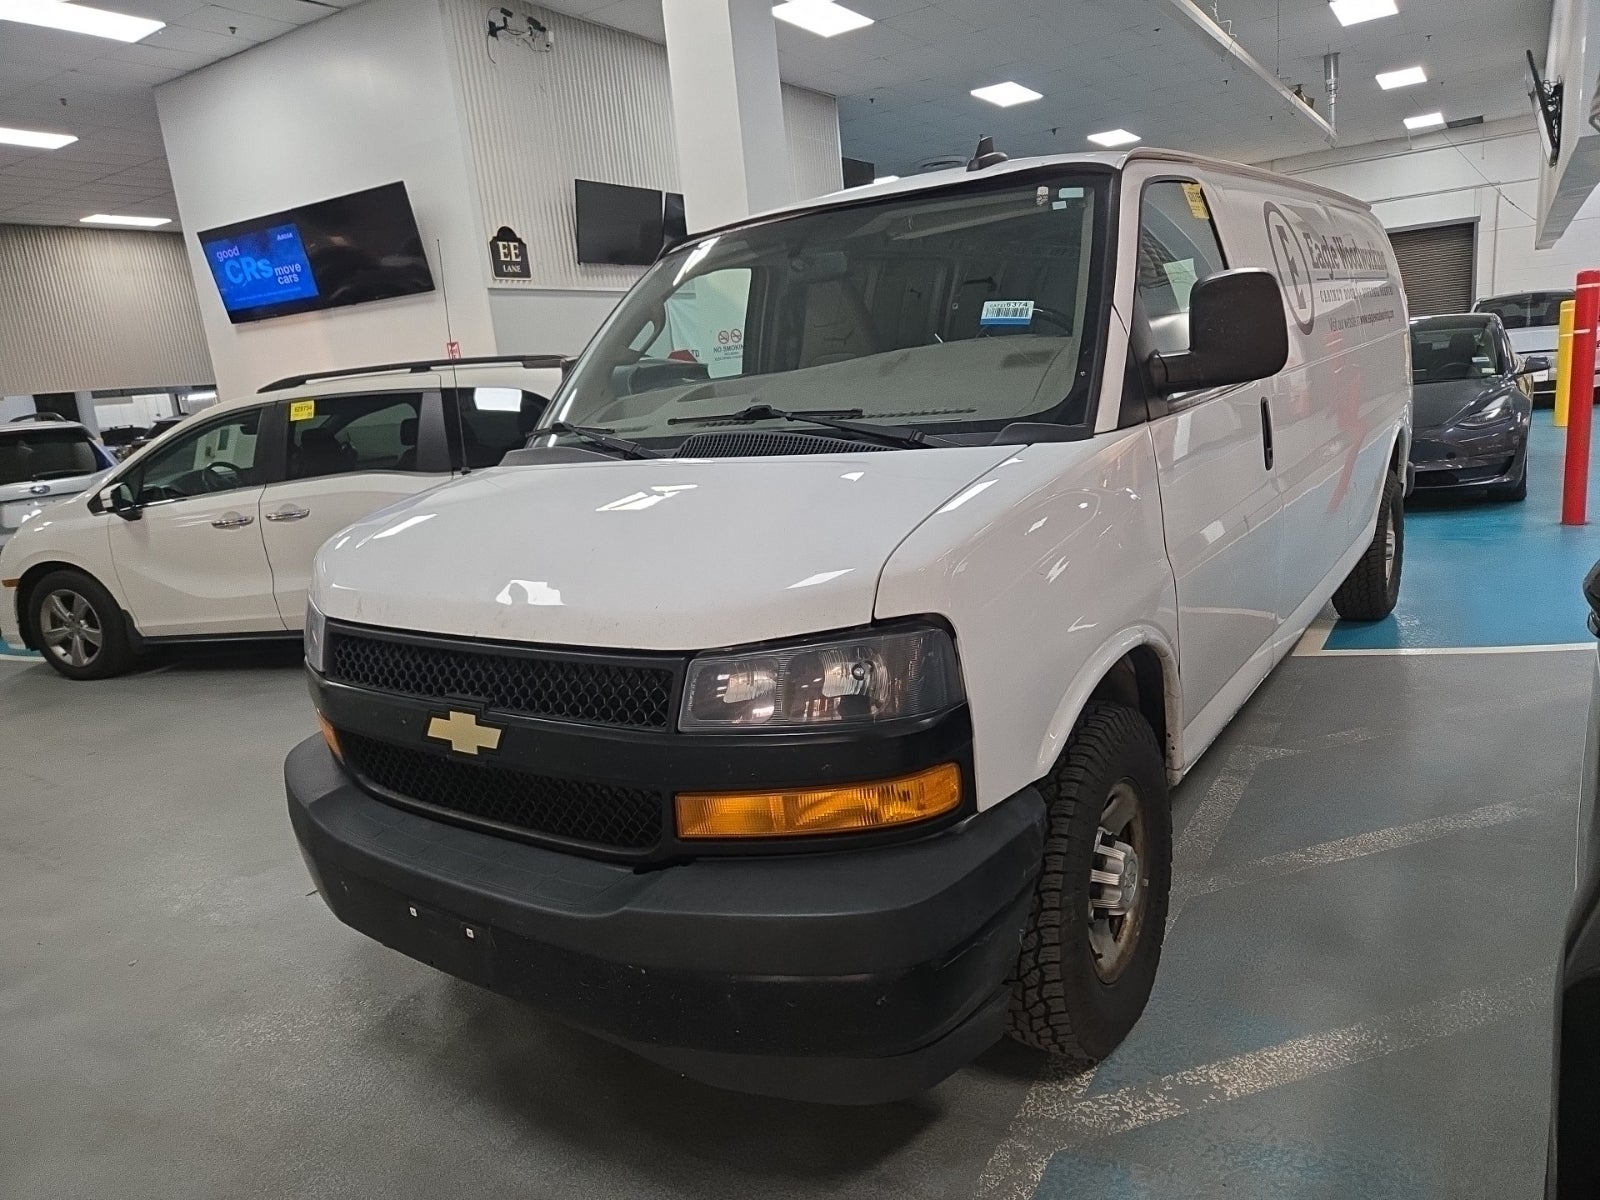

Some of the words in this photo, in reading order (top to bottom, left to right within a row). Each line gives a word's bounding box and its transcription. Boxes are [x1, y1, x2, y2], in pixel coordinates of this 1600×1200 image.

[217, 246, 240, 262] good
[497, 241, 522, 262] EE
[1302, 232, 1340, 280] Eagle
[224, 256, 274, 284] CRs
[274, 263, 301, 276] move
[503, 264, 522, 272] LANE
[278, 272, 299, 285] cars
[724, 344, 744, 352] SMOKIN
